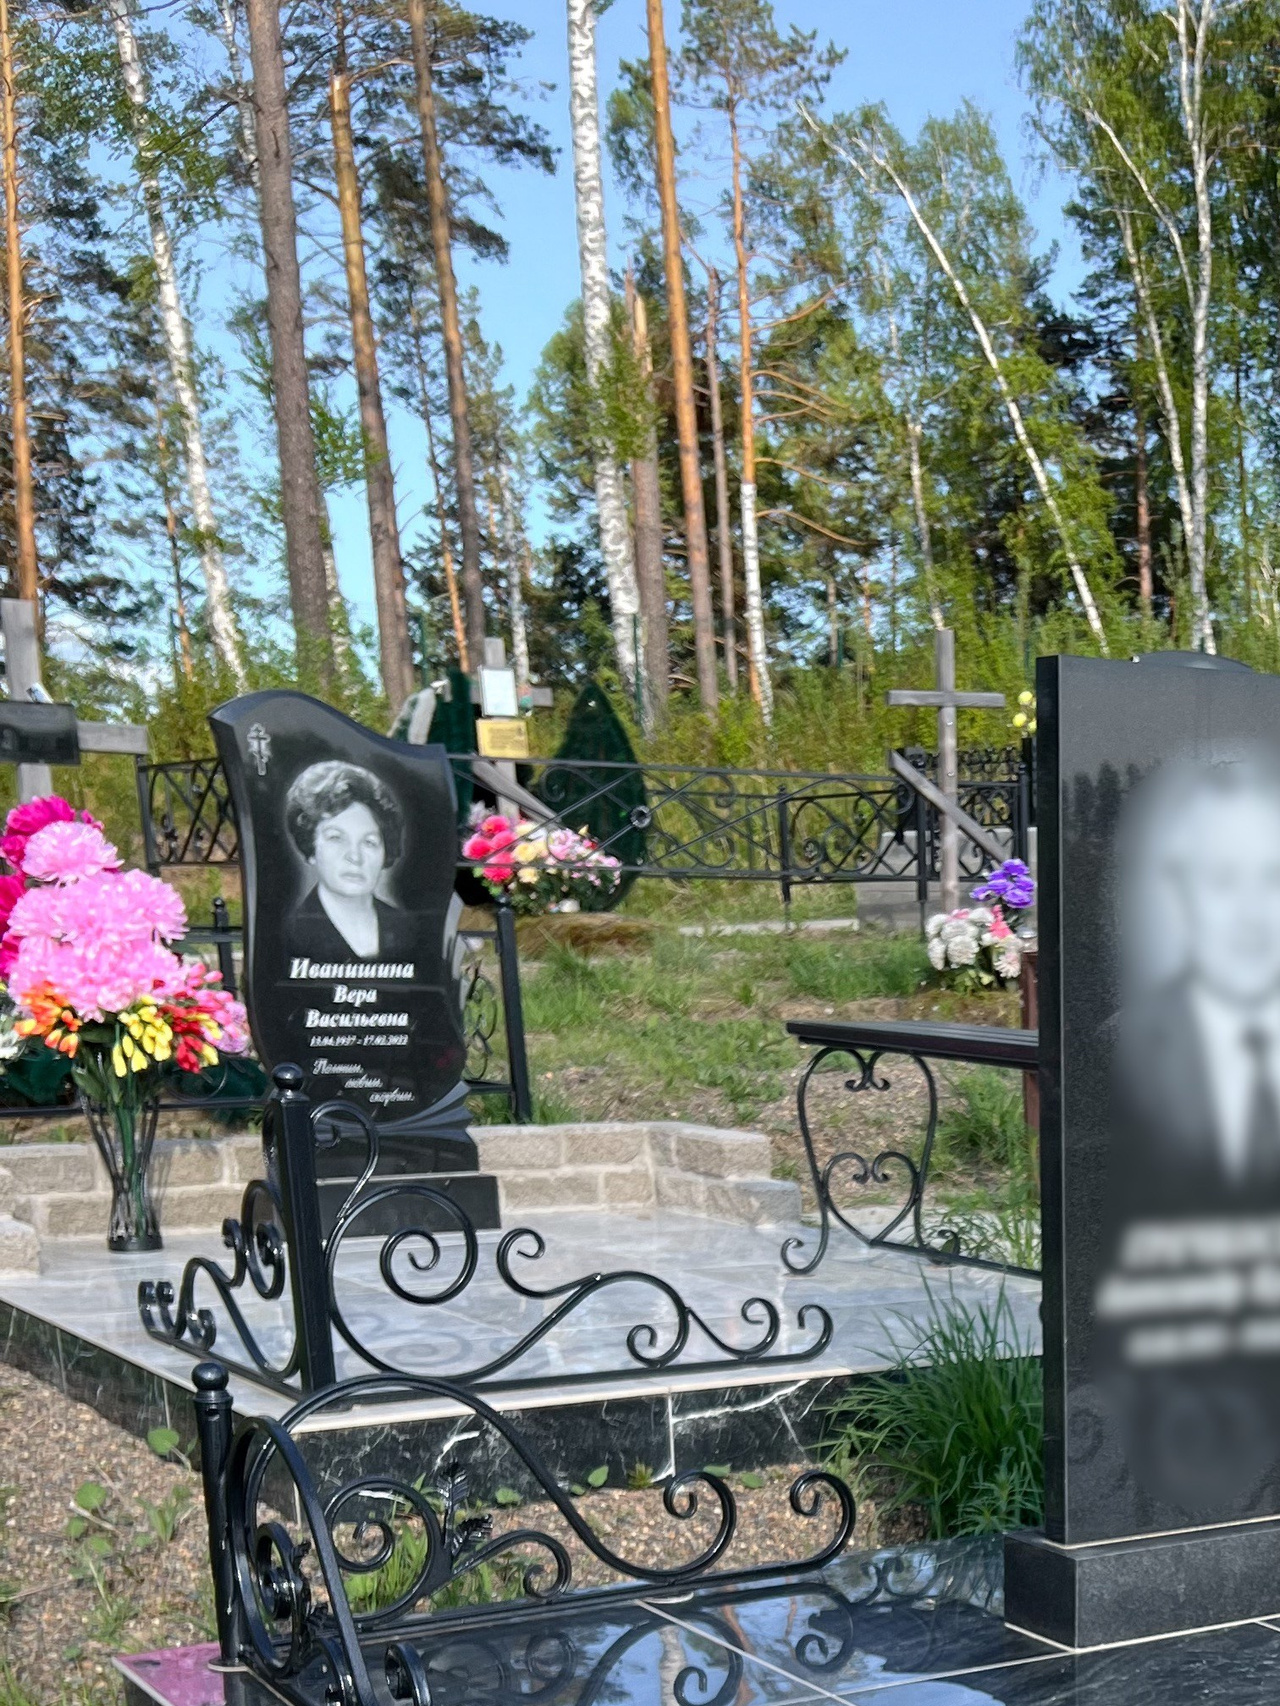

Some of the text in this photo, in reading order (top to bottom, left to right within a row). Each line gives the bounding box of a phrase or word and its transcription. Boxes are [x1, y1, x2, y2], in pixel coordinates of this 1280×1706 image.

[289, 957, 415, 979] Иванишина
[333, 984, 377, 1007] Вера
[305, 1008, 409, 1028] Васильевна
